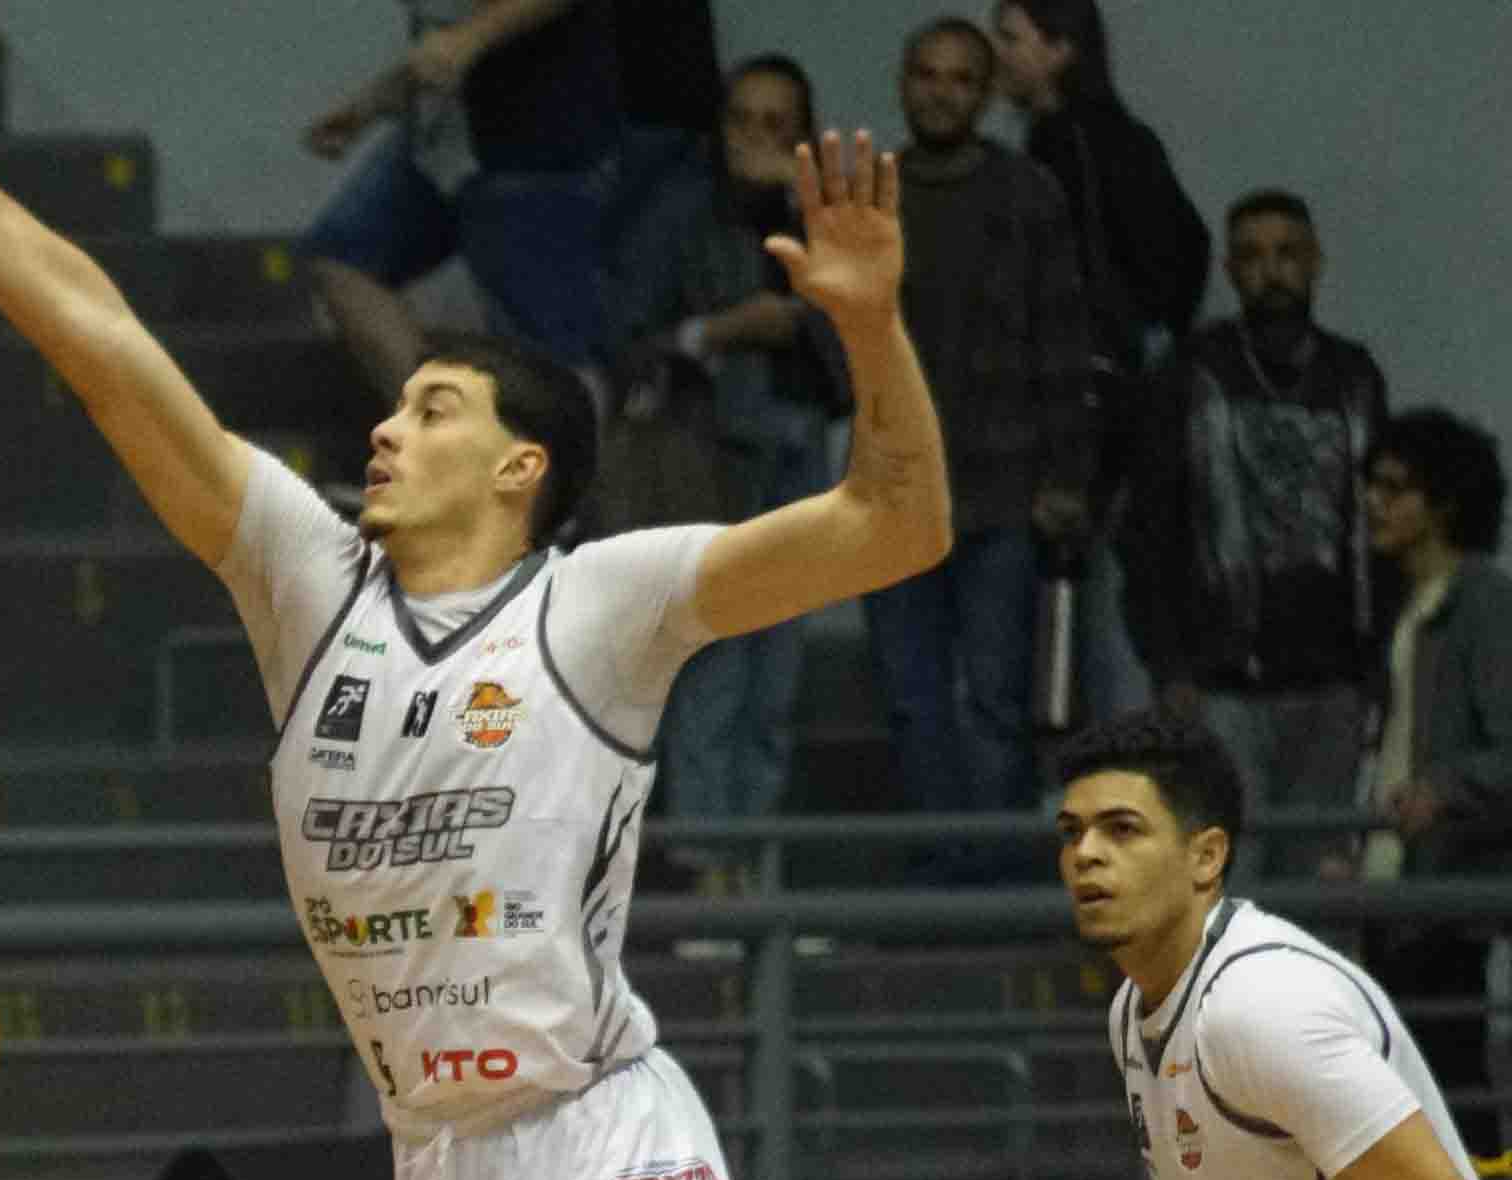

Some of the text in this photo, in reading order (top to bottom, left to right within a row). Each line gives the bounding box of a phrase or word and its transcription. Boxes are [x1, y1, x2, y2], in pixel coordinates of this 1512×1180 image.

[302, 786, 515, 840] CAXIAS
[326, 830, 475, 872] DO SUL
[422, 1048, 519, 1083] KTO
